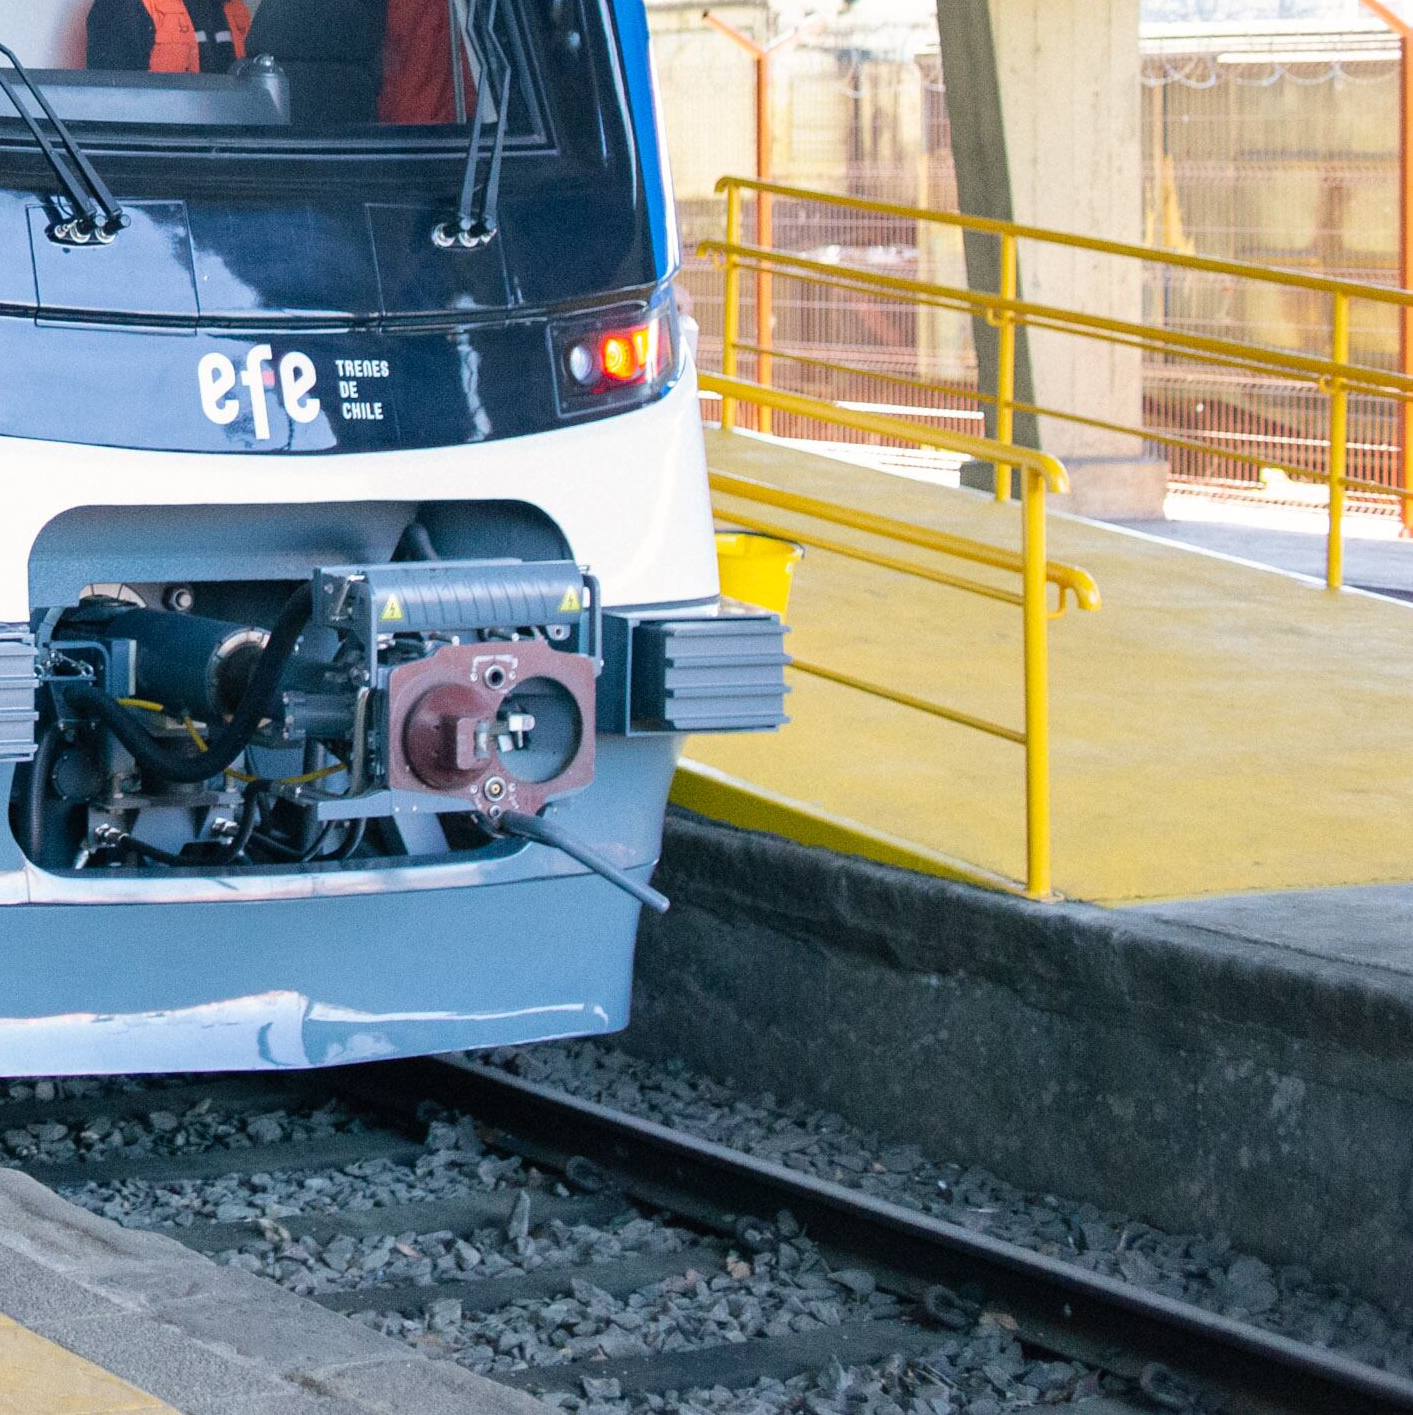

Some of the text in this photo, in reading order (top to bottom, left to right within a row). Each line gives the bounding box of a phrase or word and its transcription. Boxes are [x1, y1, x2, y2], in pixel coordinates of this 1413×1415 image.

[335, 359, 390, 378] TRENES
[197, 343, 321, 440] efe
[338, 380, 359, 399] DE
[342, 401, 384, 420] CHILE
